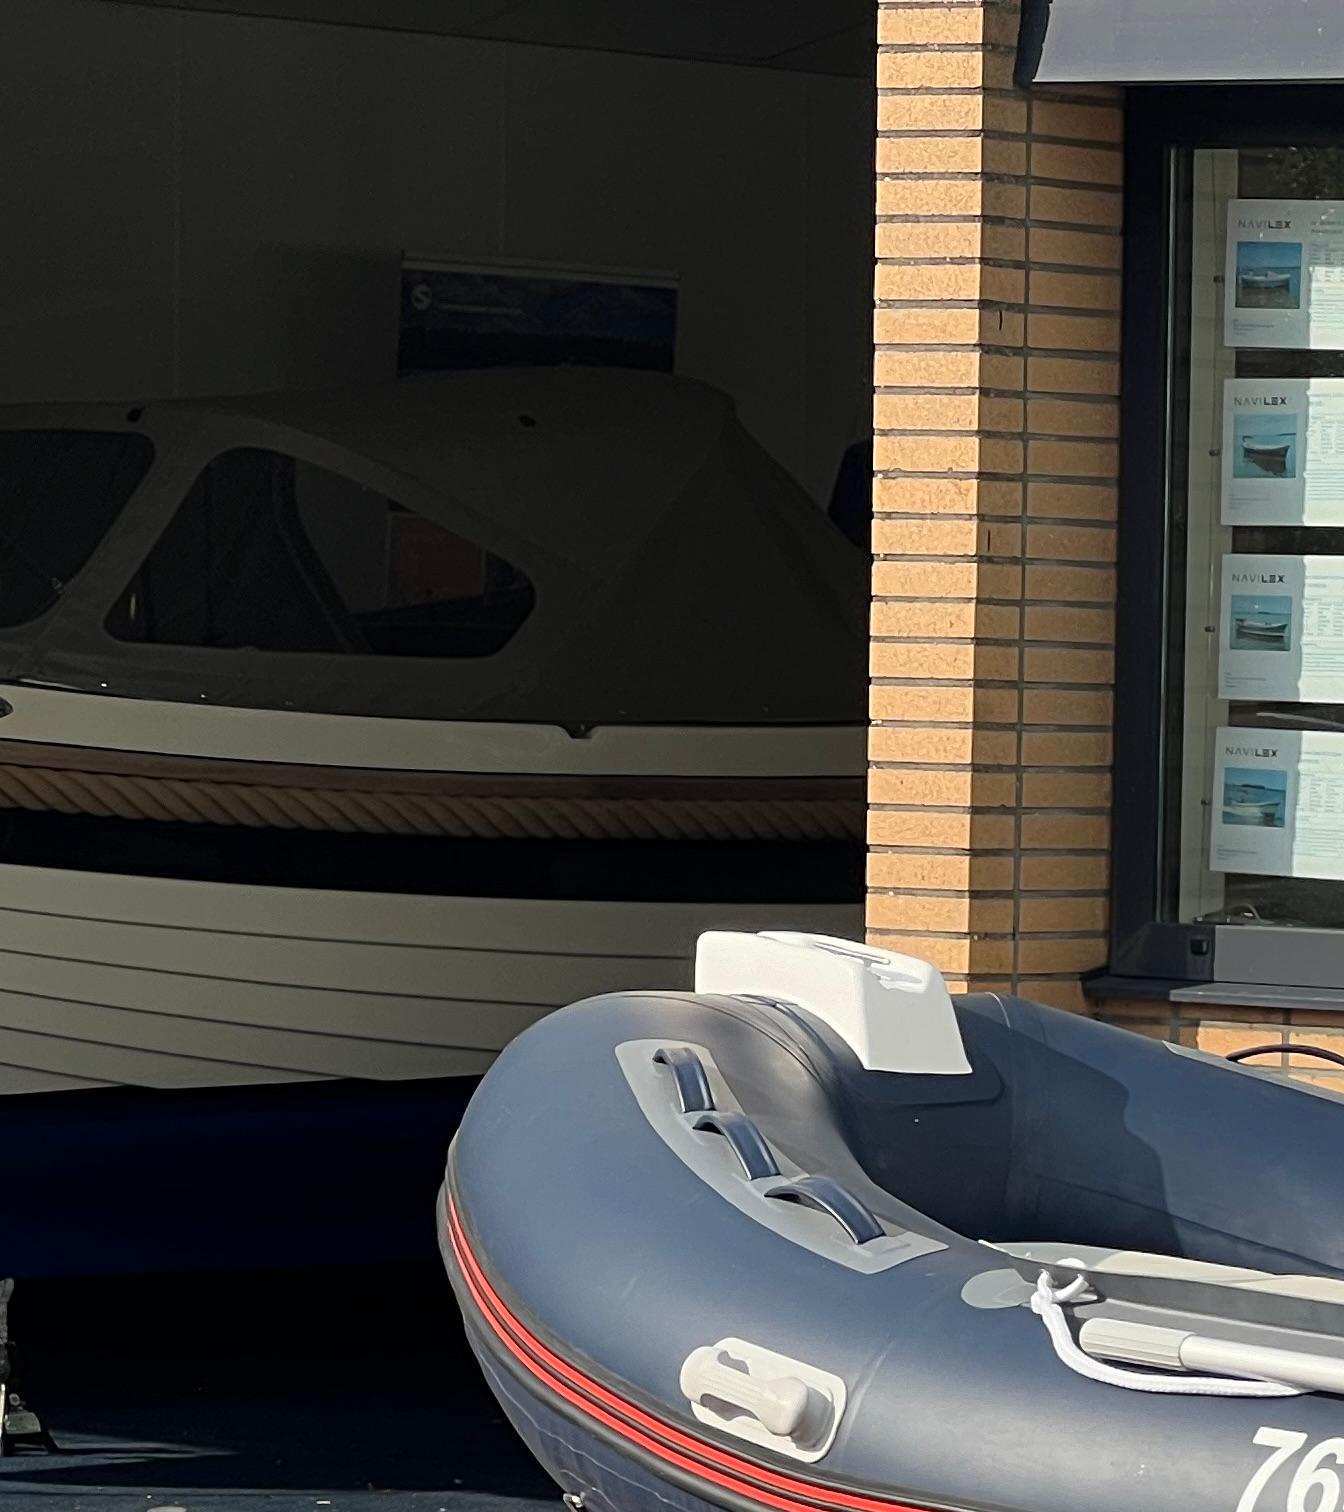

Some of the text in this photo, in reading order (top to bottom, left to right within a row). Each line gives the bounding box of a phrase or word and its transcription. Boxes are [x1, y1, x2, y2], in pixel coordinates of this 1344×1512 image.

[1237, 219, 1291, 229] NAVILEX
[1234, 396, 1287, 406] NAVILEX
[1232, 573, 1285, 583] NAVILEX
[1225, 746, 1278, 758] NAVILEX
